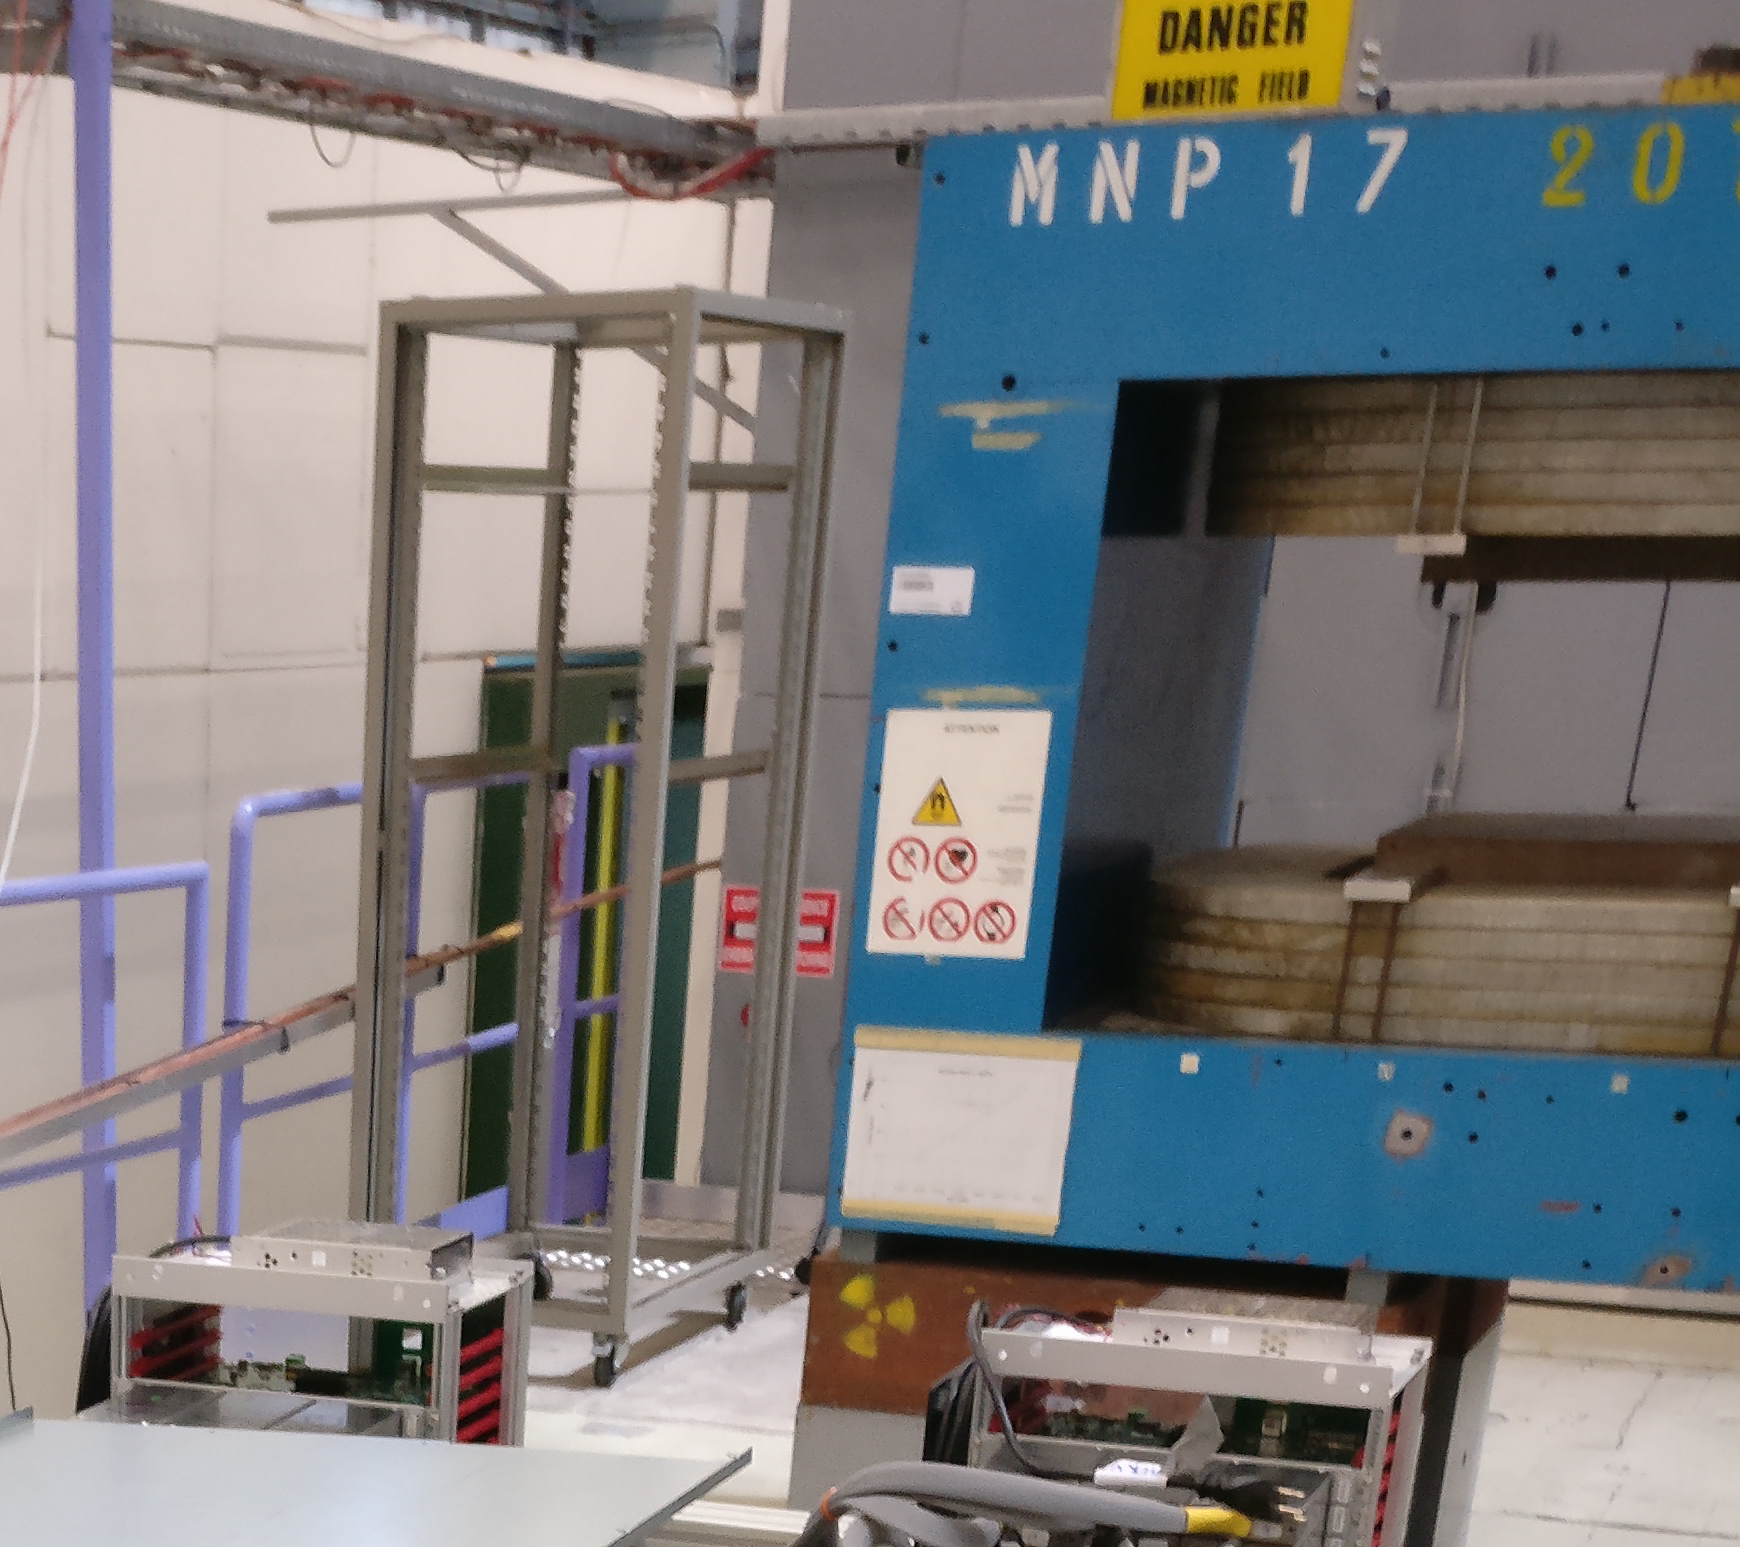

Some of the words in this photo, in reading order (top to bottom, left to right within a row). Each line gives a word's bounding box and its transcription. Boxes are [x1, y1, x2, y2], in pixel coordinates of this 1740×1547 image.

[1158, 1, 1308, 54] DANGER
[1143, 74, 1239, 109] MAGNETIC
[1258, 69, 1310, 102] FIELD
[1010, 135, 1221, 226] MNP
[1288, 127, 1408, 214] 17
[1542, 122, 1740, 208] 20
